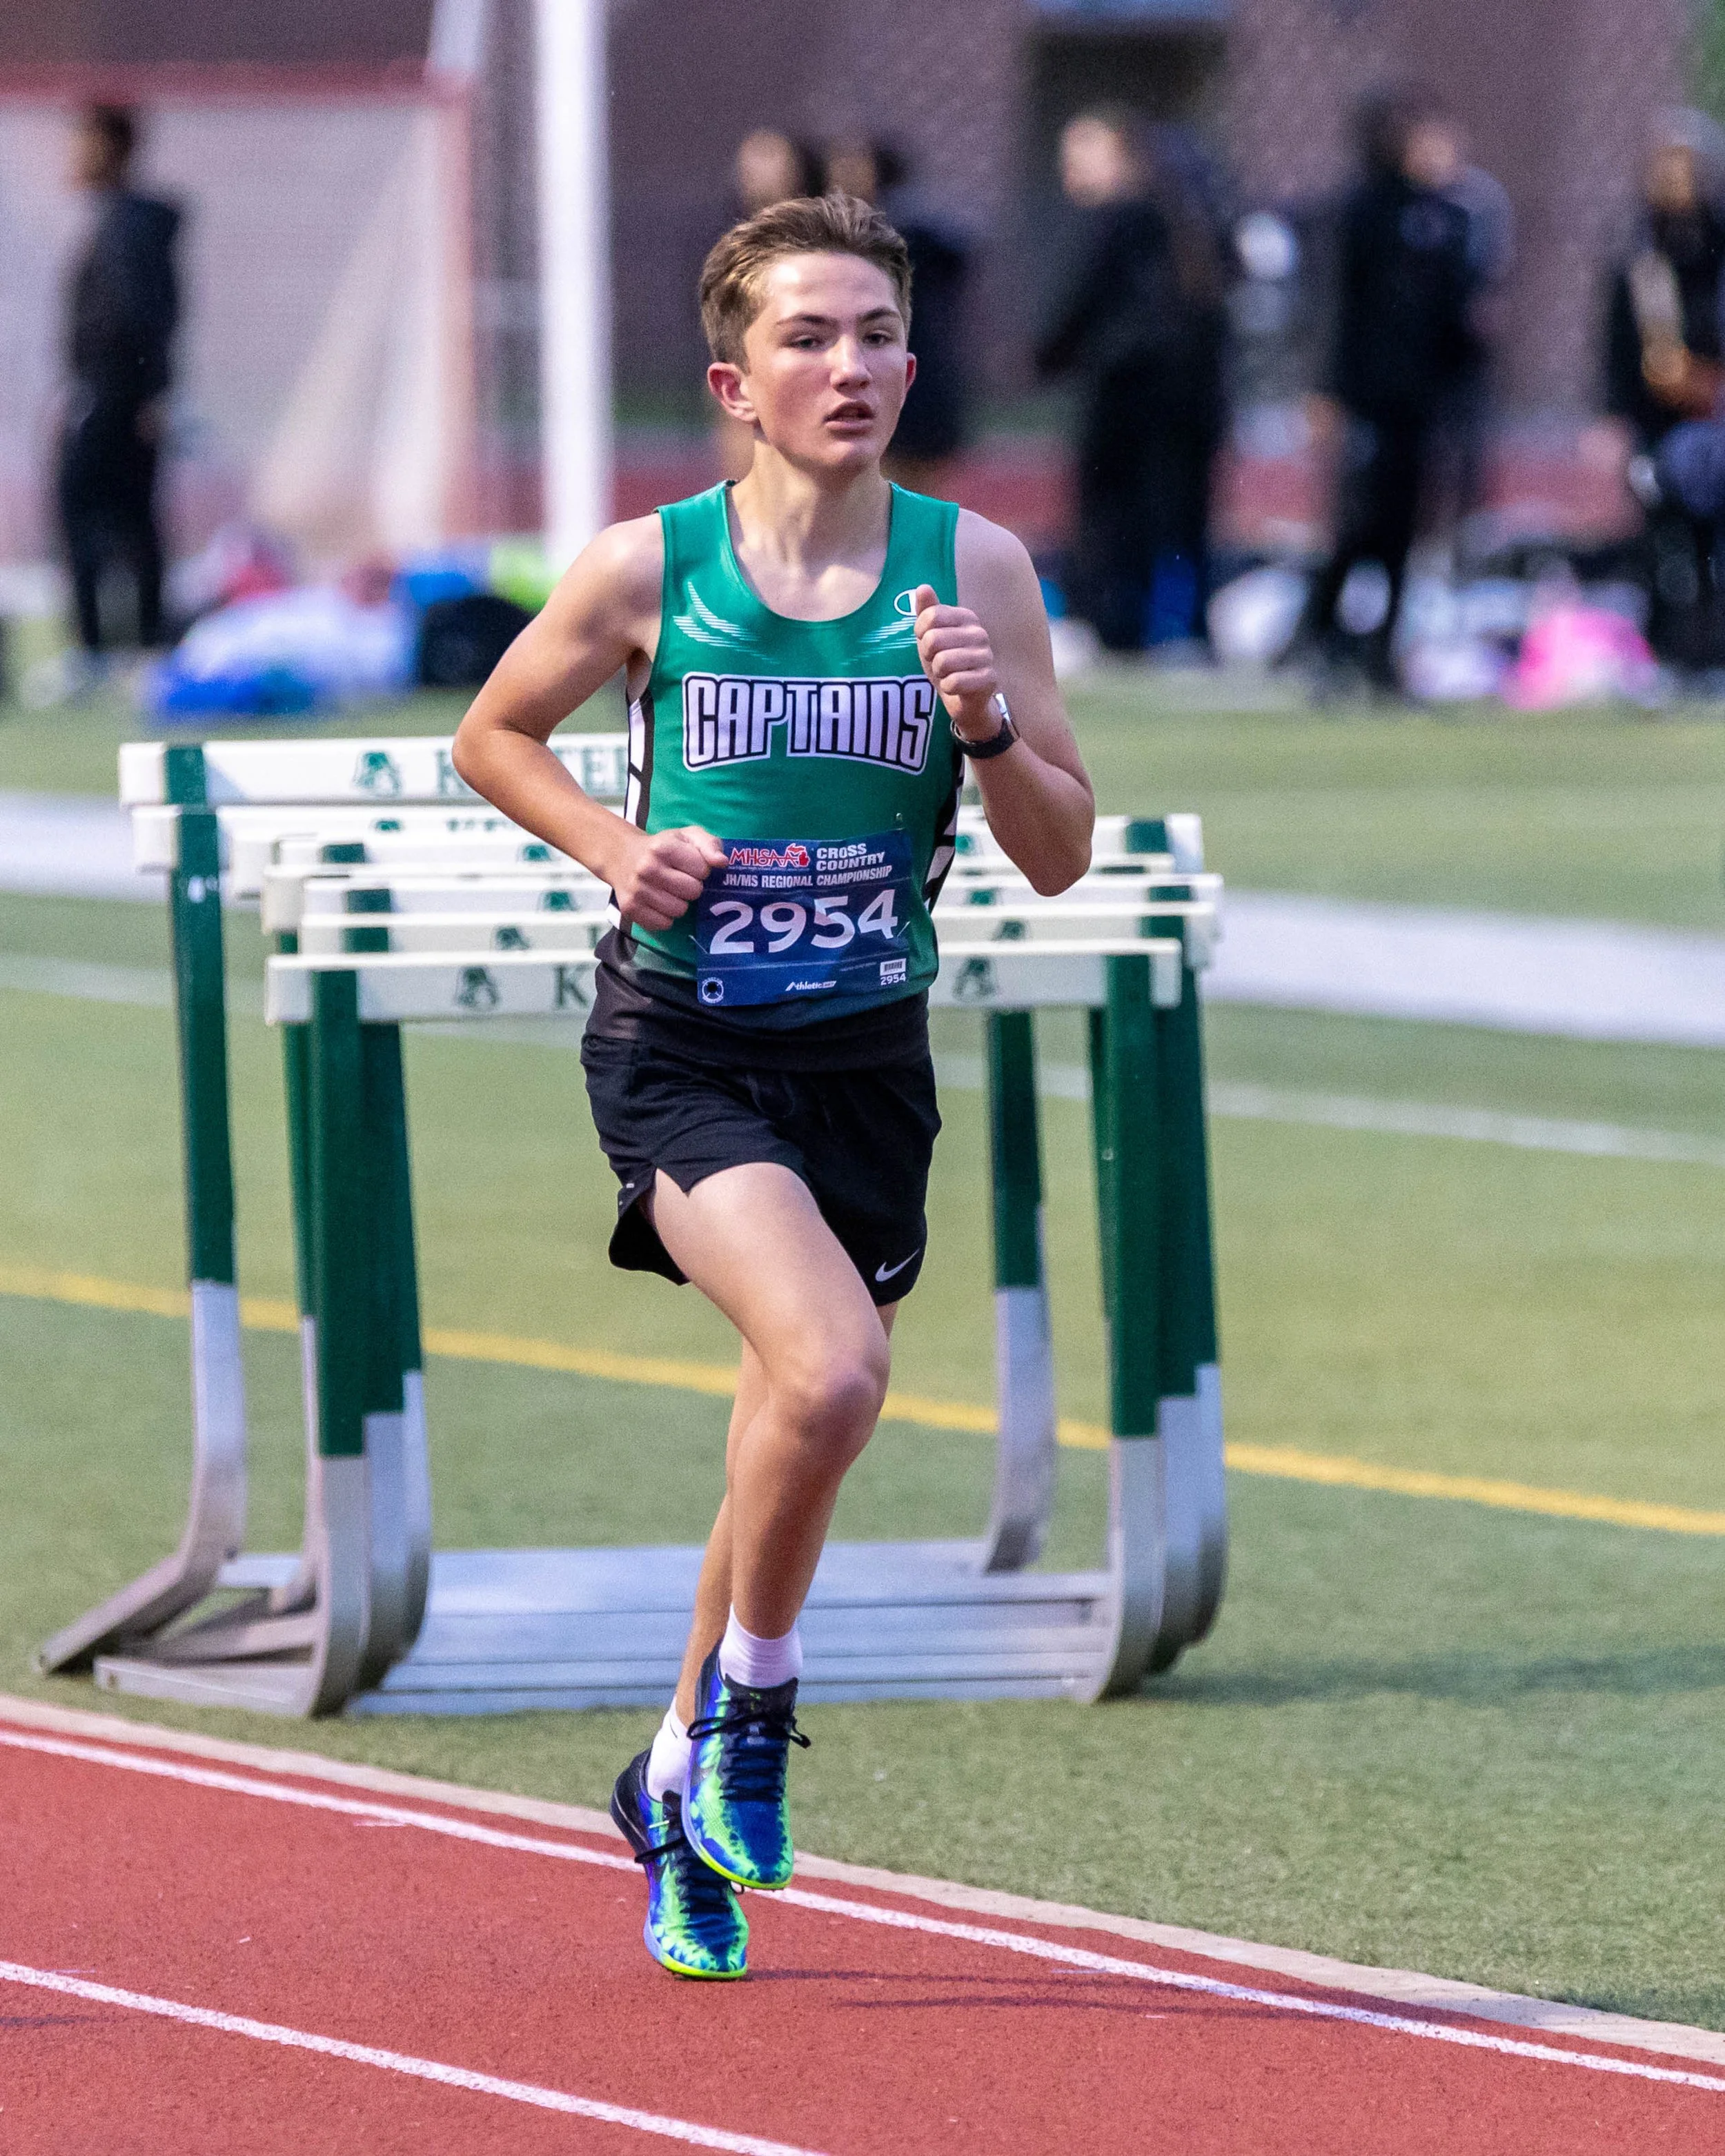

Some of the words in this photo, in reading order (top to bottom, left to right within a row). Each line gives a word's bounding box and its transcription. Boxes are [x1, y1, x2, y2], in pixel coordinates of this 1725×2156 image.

[683, 673, 936, 773] CAPTAINS
[729, 846, 800, 868] MHSAA
[816, 843, 867, 859] CROSS
[816, 851, 885, 871] COUNTRY
[723, 874, 758, 887] JH/MS
[761, 875, 813, 889] REGIONAL
[817, 865, 893, 887] CHAMPIONSHIP
[709, 889, 898, 955] 2954
[880, 973, 906, 986] 2954
